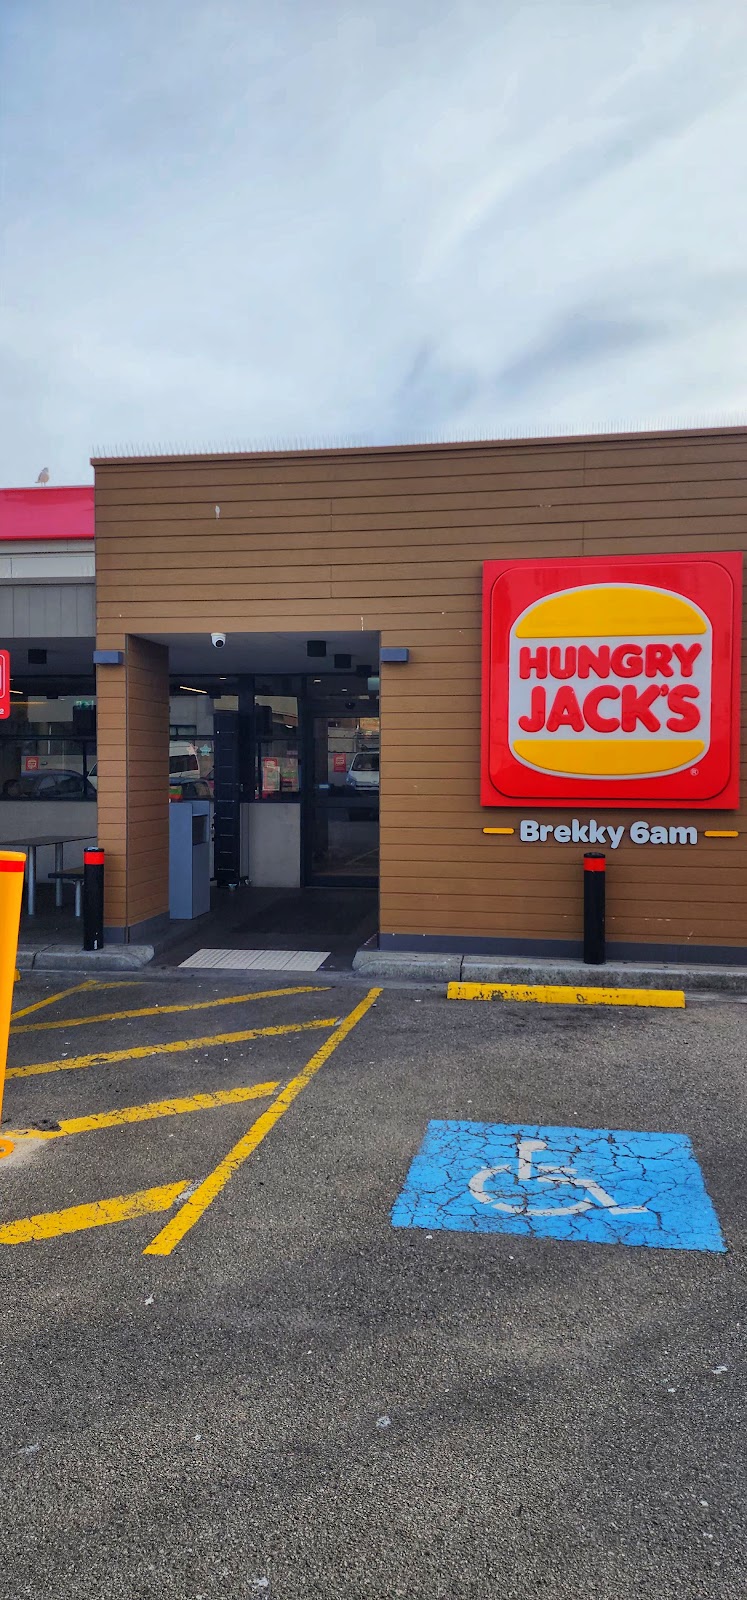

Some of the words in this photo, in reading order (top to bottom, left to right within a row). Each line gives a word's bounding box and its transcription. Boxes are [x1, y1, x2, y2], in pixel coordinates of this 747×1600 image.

[519, 644, 702, 679] HUNGRY
[519, 684, 701, 733] JACK'S
[520, 818, 625, 849] Brekky
[630, 820, 698, 845] 6am
